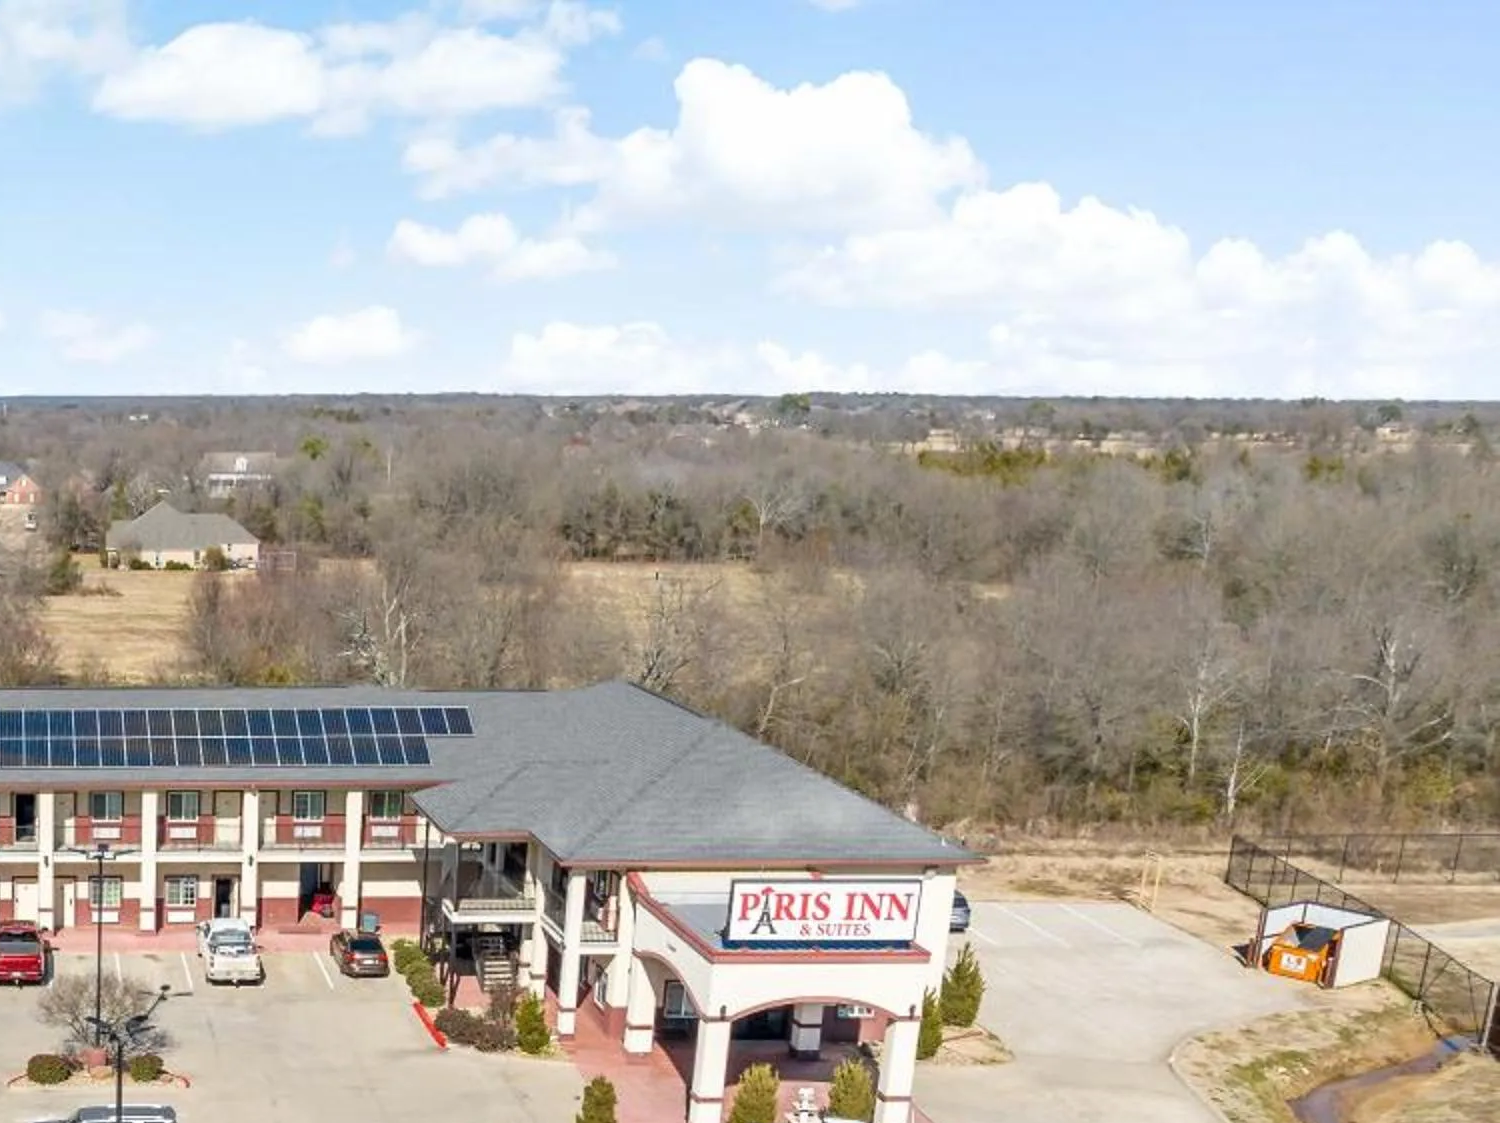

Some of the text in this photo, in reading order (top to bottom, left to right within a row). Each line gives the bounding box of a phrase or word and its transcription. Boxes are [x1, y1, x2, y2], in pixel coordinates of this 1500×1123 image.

[738, 887, 915, 935] PARIS INN
[799, 923, 872, 936] & SUITES
